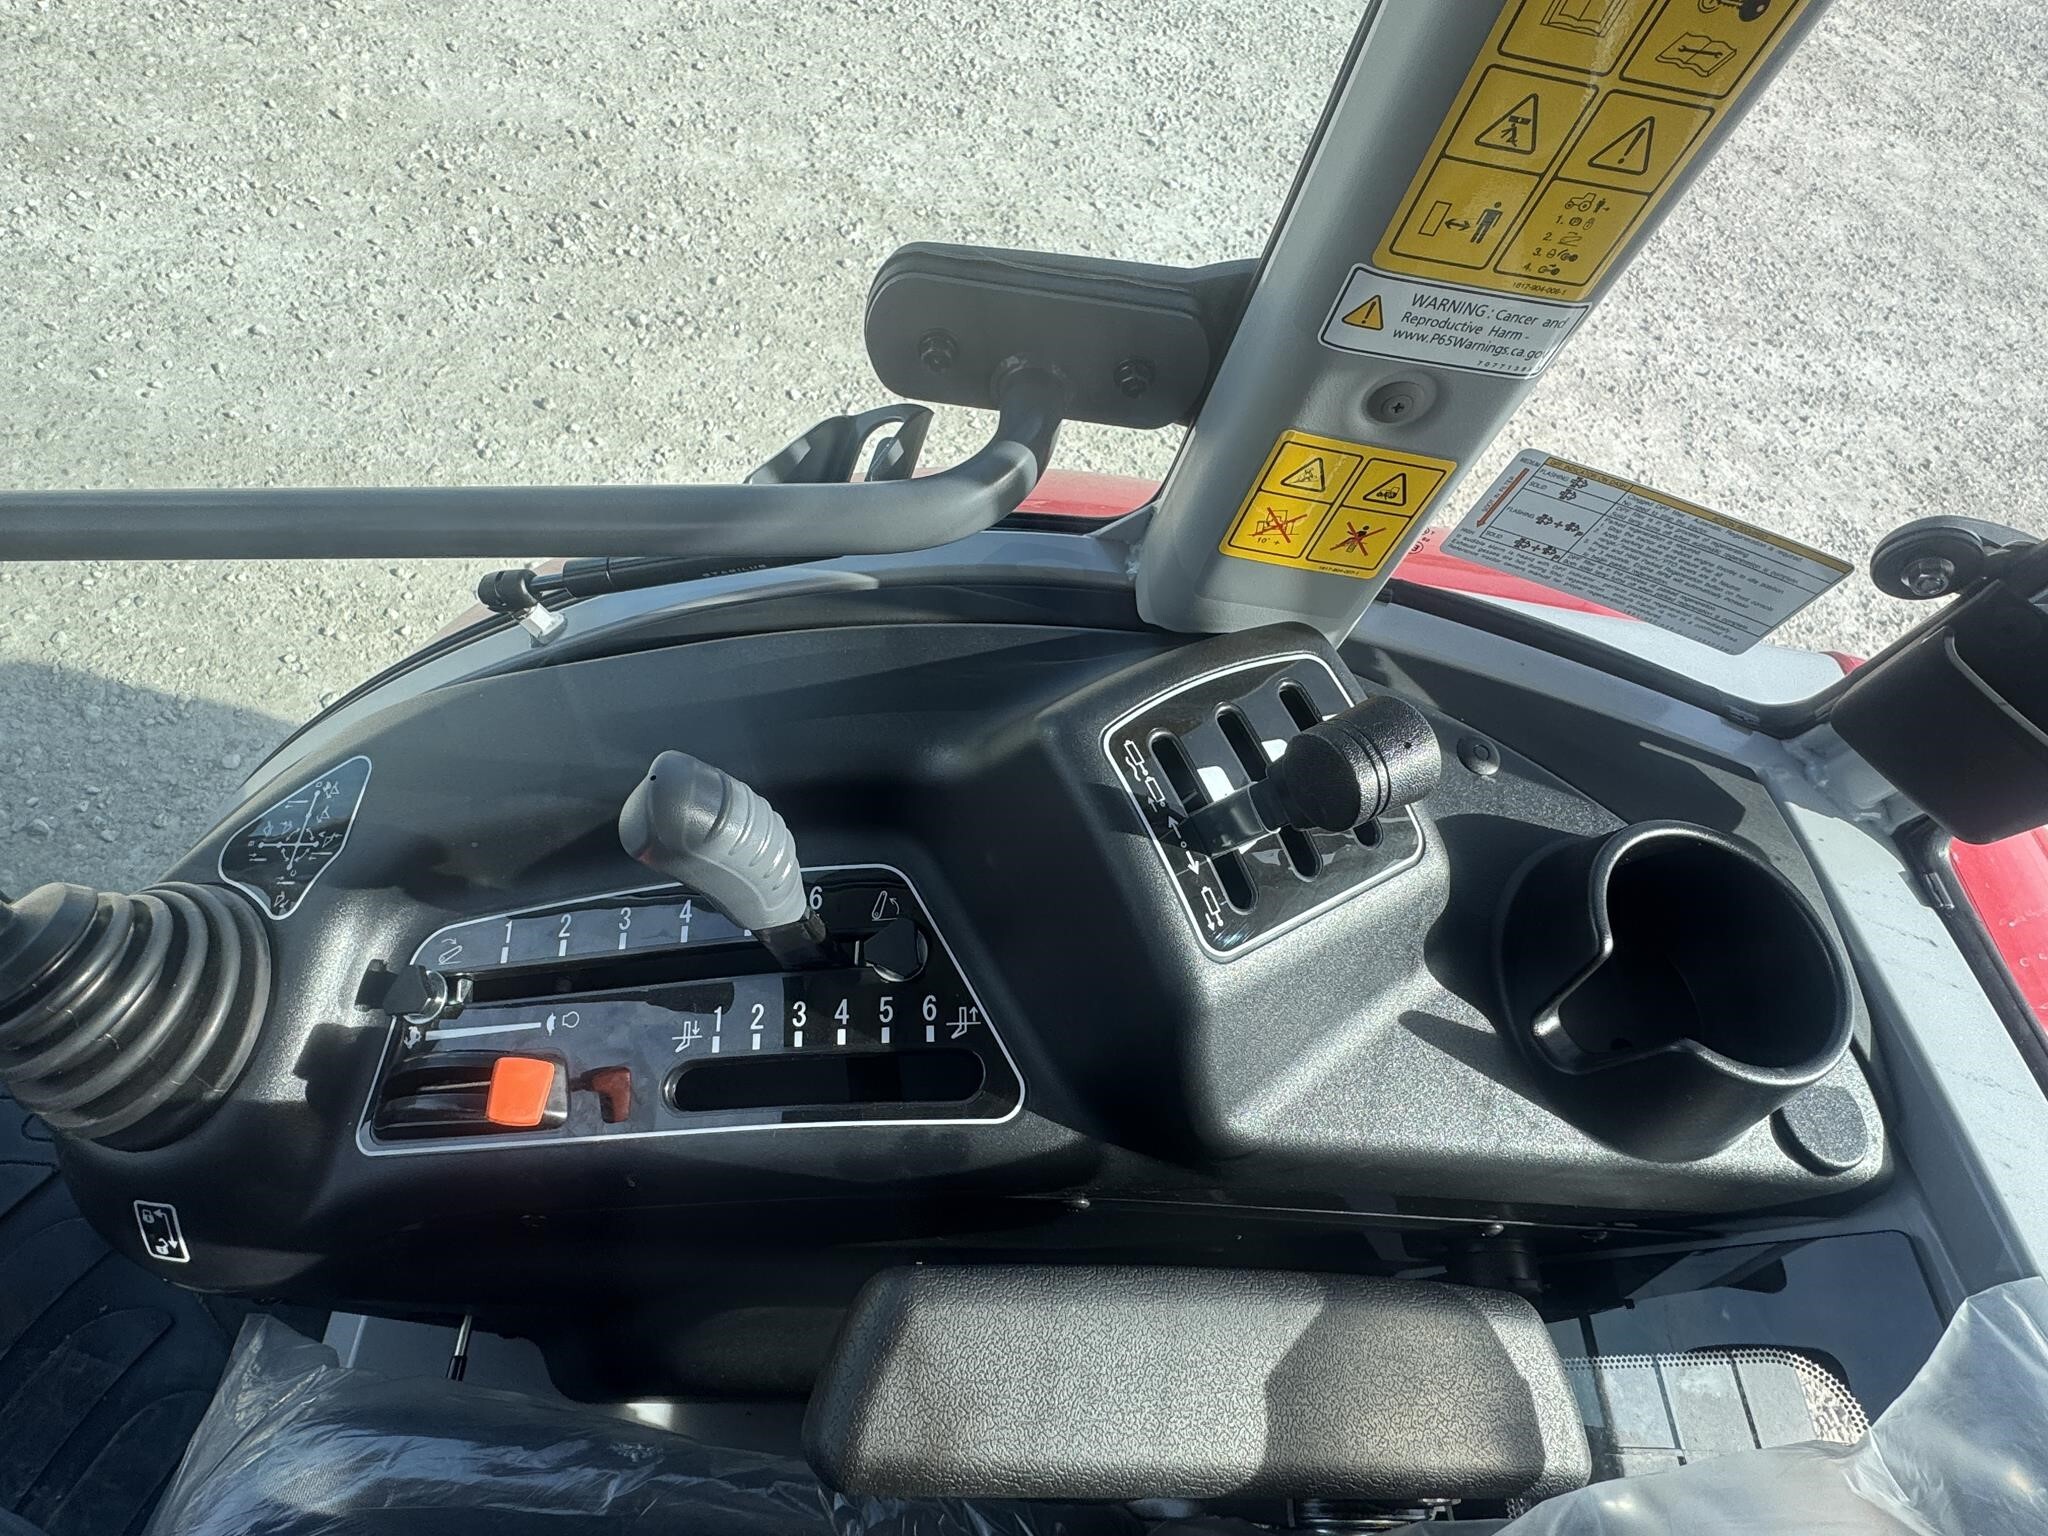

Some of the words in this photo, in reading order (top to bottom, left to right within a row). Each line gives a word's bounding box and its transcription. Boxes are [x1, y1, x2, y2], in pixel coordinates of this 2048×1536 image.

[1400, 311, 1484, 336] Reproductive
[1487, 326, 1523, 341] Harm
[1495, 309, 1538, 326] Cancer
[1542, 317, 1570, 330] and
[679, 899, 692, 923] 4
[809, 886, 823, 910] 6
[558, 914, 571, 938] 2
[619, 907, 631, 930] 3
[505, 920, 512, 944] 1
[714, 1006, 723, 1032] 1
[751, 1003, 765, 1029] 2
[792, 1001, 807, 1027] 3
[834, 999, 850, 1025] 4
[879, 996, 893, 1023] 5
[922, 995, 937, 1021] 6
